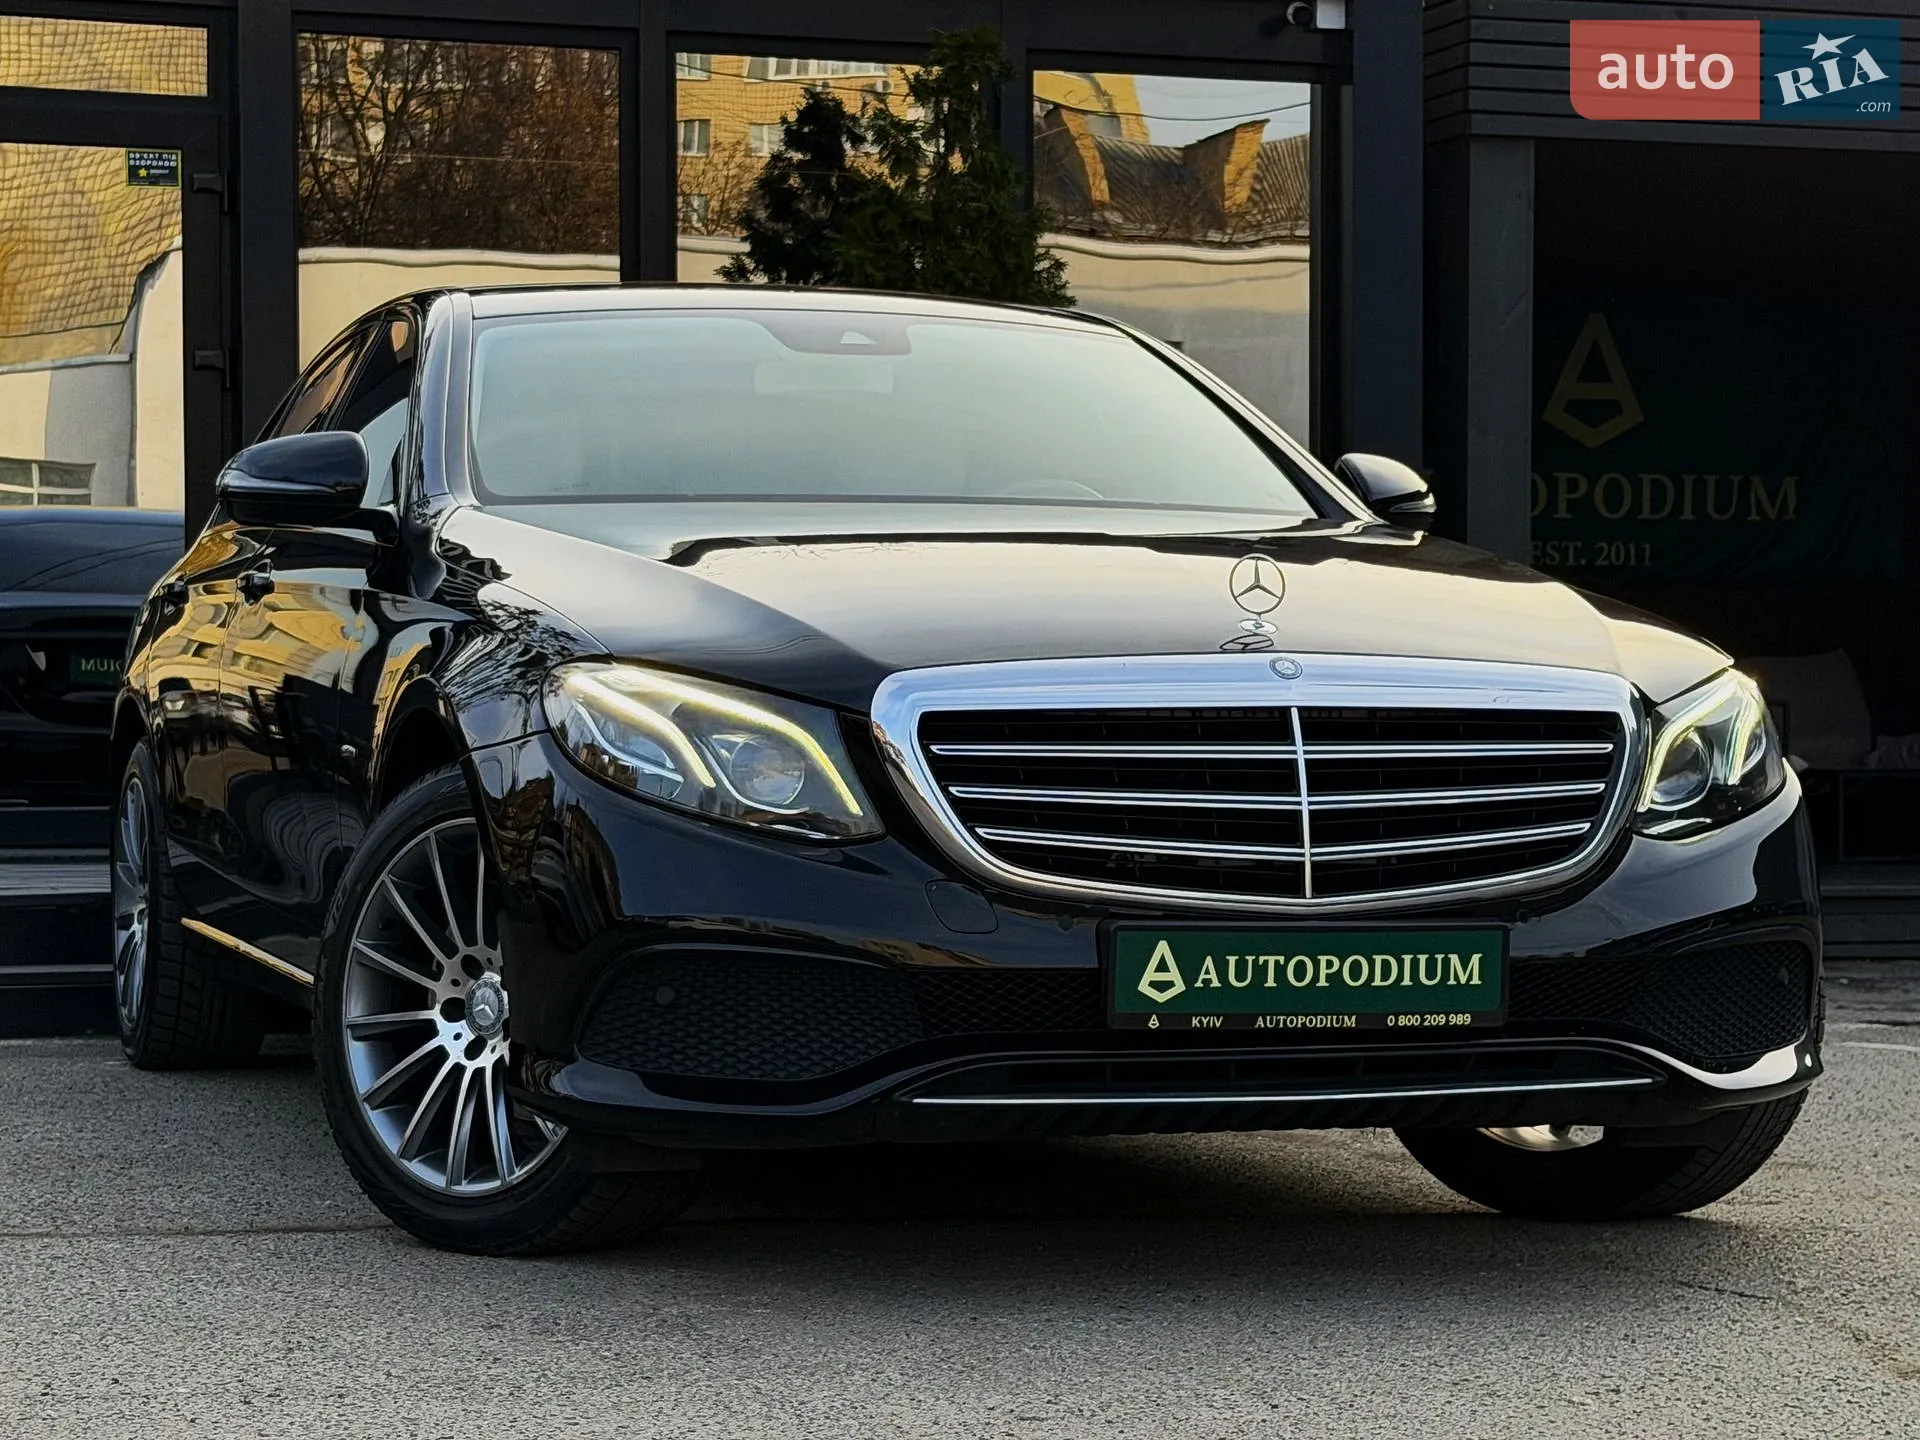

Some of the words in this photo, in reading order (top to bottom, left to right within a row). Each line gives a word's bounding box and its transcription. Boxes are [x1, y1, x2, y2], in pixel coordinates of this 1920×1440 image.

[1594, 540, 1653, 566] 2011
[1194, 953, 1484, 988] AUTOPODIUM
[1191, 1015, 1224, 1029] KYIV
[1254, 1015, 1357, 1029] AUTOPODIUM
[1397, 1014, 1421, 1027] 800
[1423, 1014, 1446, 1026] 209
[1448, 1013, 1472, 1026] 989
